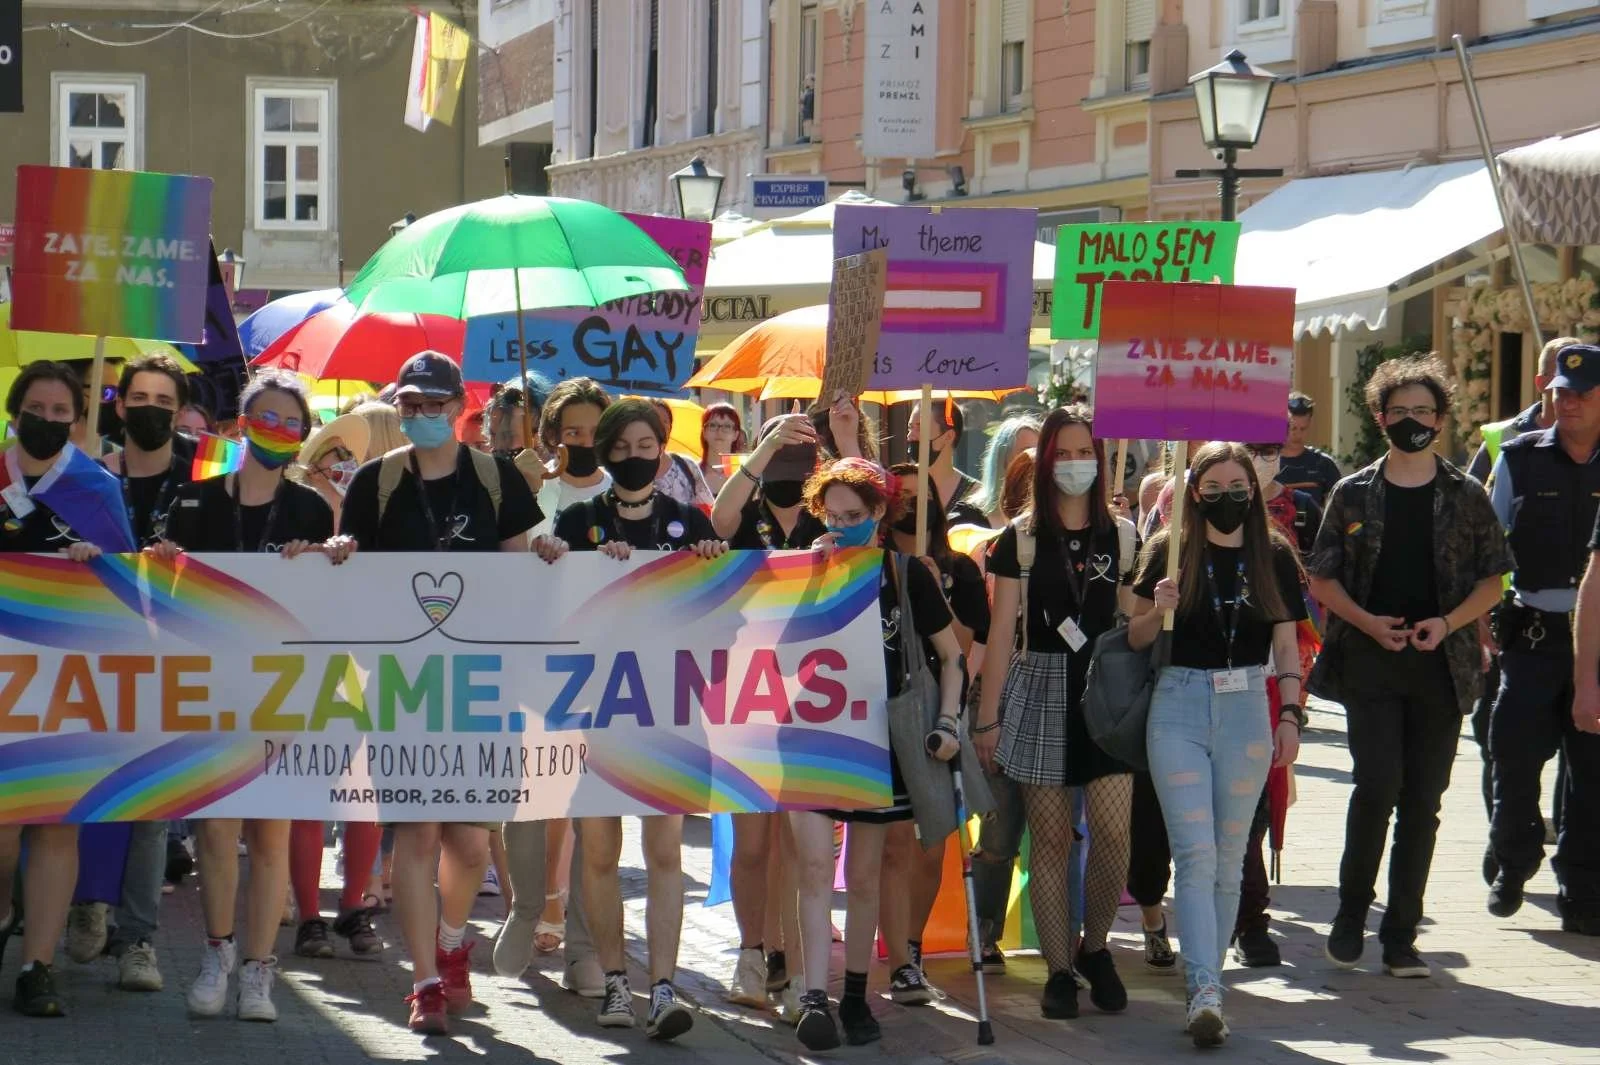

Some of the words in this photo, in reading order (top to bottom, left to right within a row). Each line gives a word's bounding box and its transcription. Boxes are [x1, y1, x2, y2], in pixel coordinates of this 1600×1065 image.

[770, 183, 809, 193] EXPRES
[43, 232, 116, 257] ZATE.
[120, 236, 201, 261] ZAME.
[918, 224, 982, 255] theme
[1079, 231, 1147, 265] MALO
[1152, 228, 1216, 266] SEM
[64, 260, 98, 281] ZA
[116, 264, 175, 288] NAS.
[489, 337, 559, 363] LESS
[572, 315, 685, 382] GAY
[873, 351, 892, 374] is
[918, 349, 1001, 374] love.
[1127, 338, 1194, 361] ZATE.
[1200, 338, 1278, 365] ZAME.
[1145, 364, 1176, 388] ZA
[1192, 365, 1249, 392] NAS.
[0, 654, 237, 733] ZATE.
[250, 653, 527, 733] ZAME.
[544, 650, 656, 733] ZA
[674, 648, 868, 726] NAS.
[366, 743, 465, 778] PONOSA
[330, 788, 427, 806] MARIBOR,
[431, 788, 460, 804] 26.
[465, 788, 482, 804] 6.
[486, 788, 530, 804] 2021
